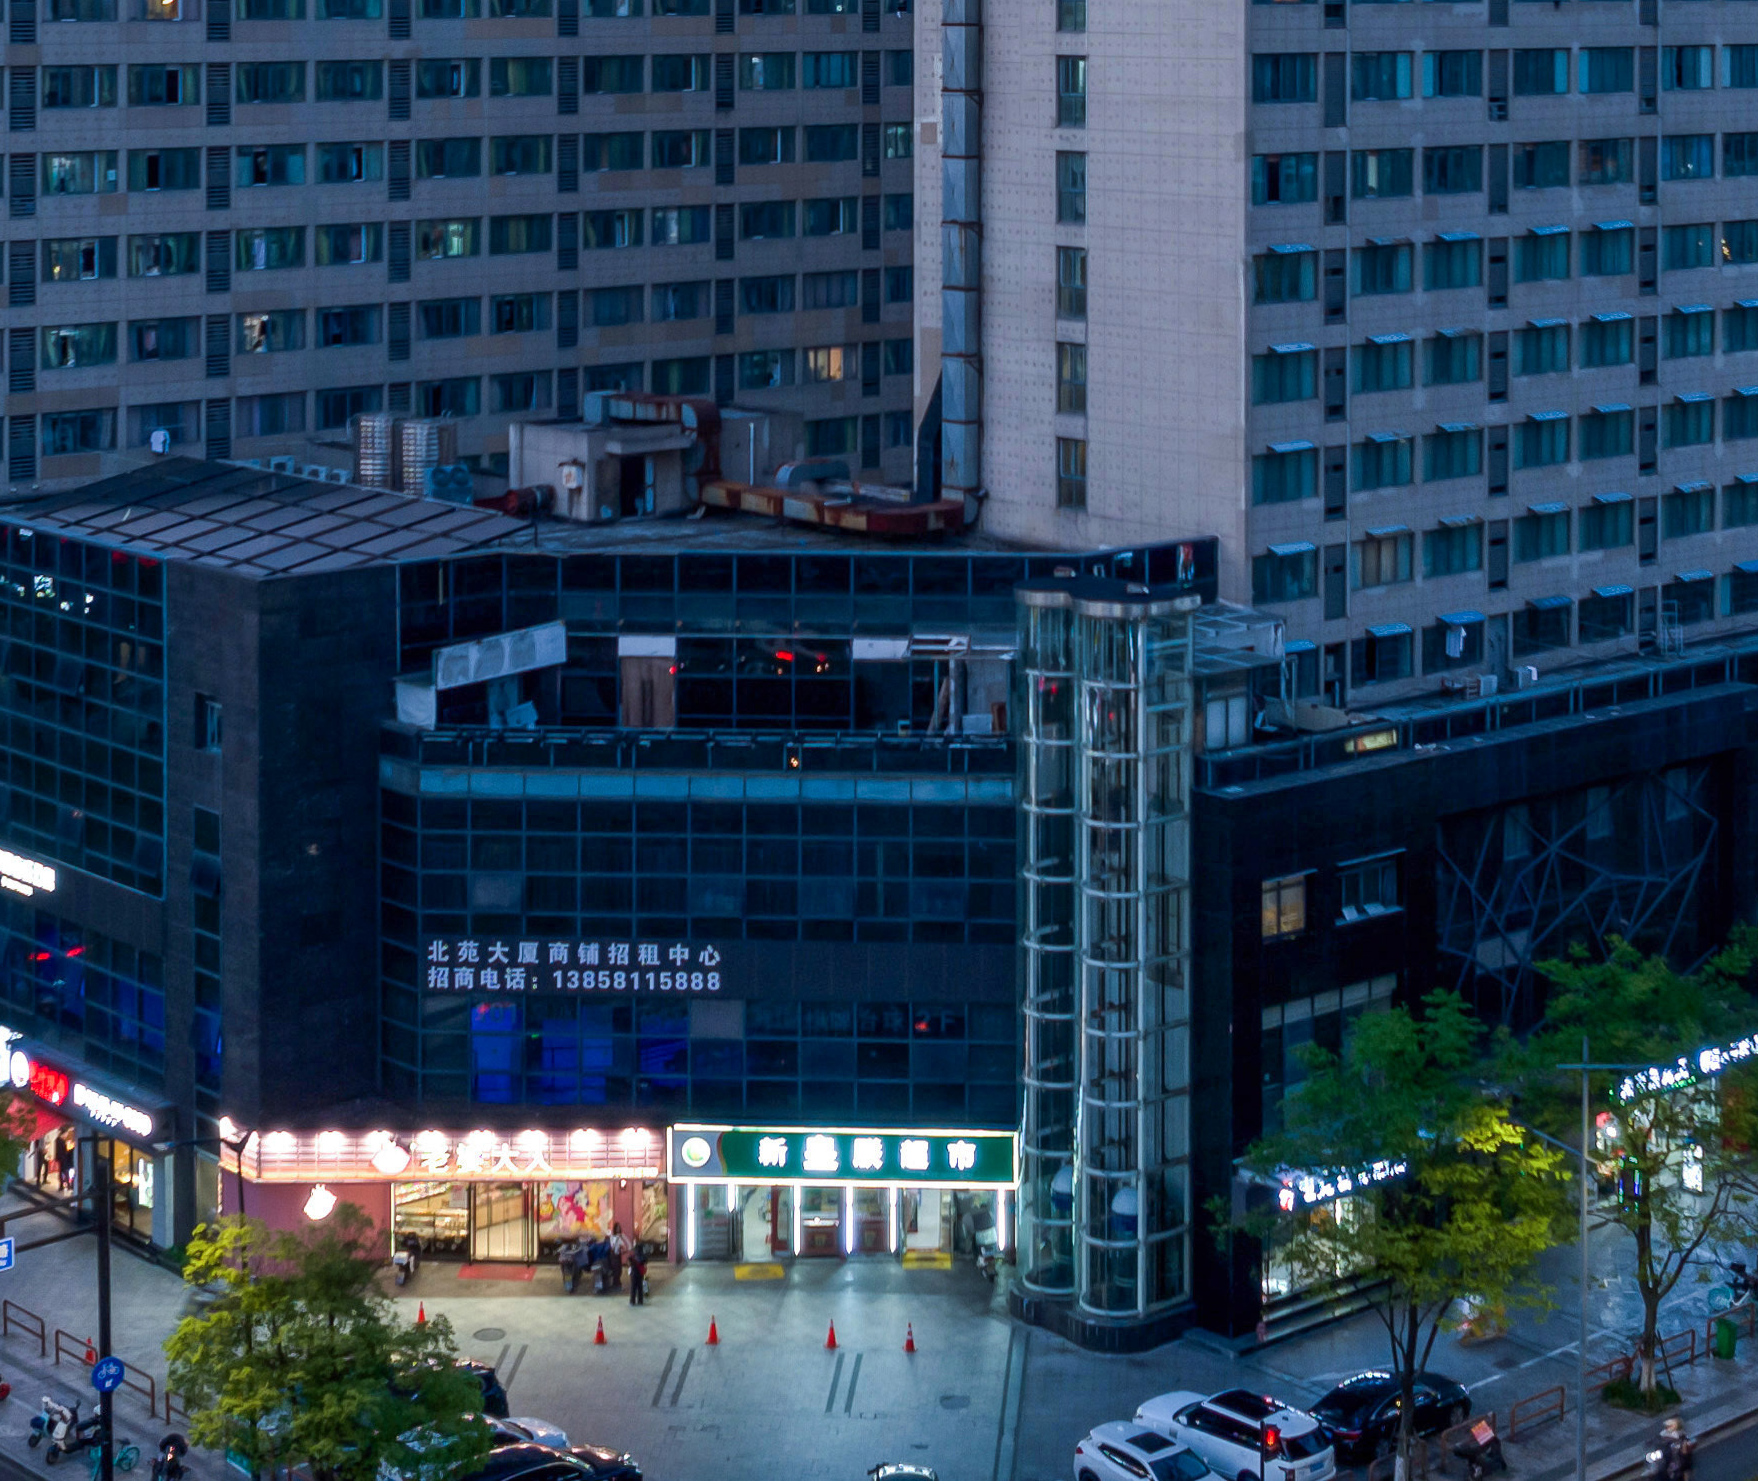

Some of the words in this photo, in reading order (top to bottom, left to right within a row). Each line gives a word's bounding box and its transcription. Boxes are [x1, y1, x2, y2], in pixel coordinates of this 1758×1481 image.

[428, 940, 720, 966] 北苑大厦商铺招租中心
[552, 970, 721, 991] 13858115888
